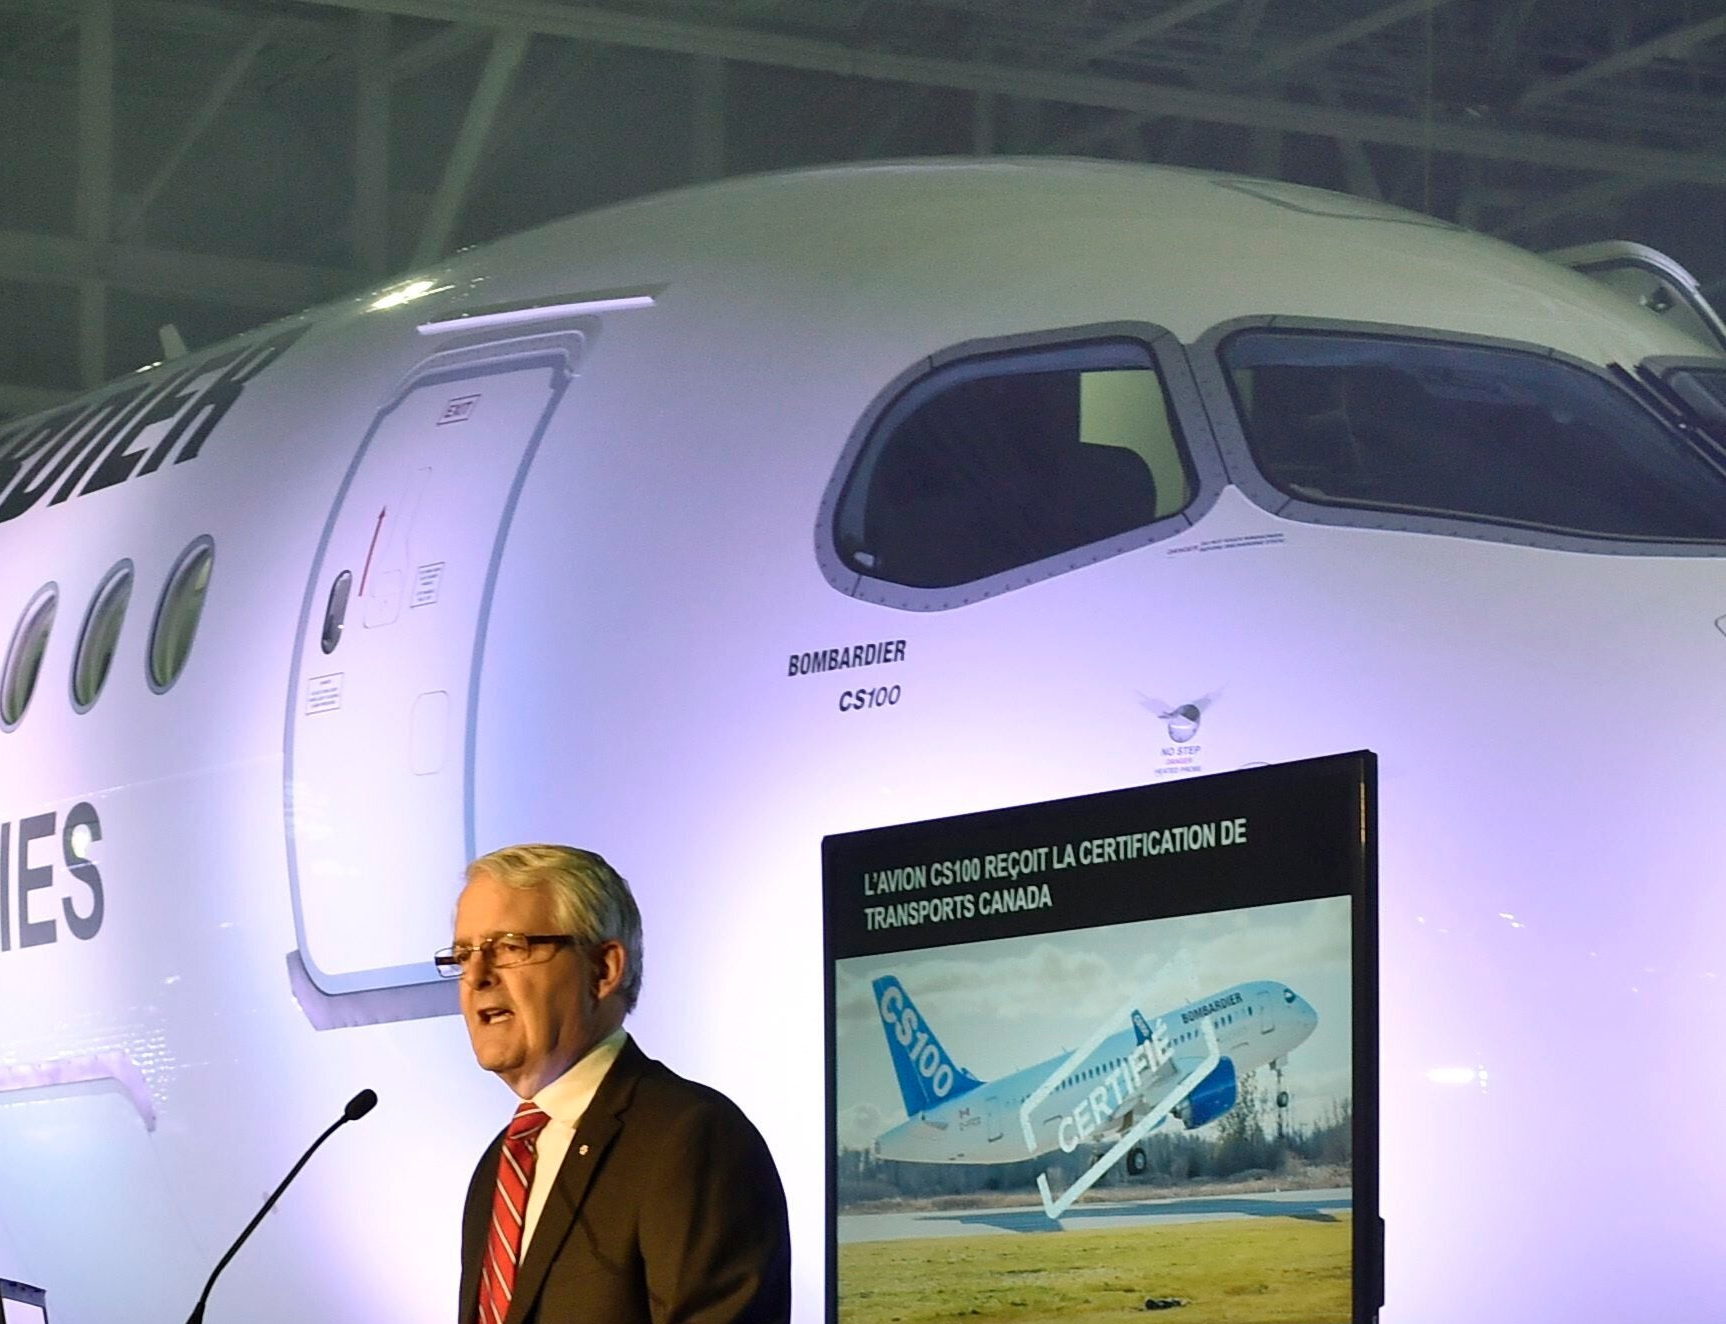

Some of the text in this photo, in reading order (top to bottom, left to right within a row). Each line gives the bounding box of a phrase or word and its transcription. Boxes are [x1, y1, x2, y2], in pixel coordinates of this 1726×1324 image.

[787, 639, 907, 677] BOMBARDIER
[839, 684, 901, 712] CS100
[864, 818, 1248, 897] L'AVION CS100 REÇOIT LA CERTIFICATION DE
[864, 884, 1053, 931] TRANSPORTS CANADA
[1181, 992, 1243, 1024] BOMBARDIER
[880, 986, 954, 1098] CS100
[1057, 1018, 1174, 1153] CERTIFIÉ
